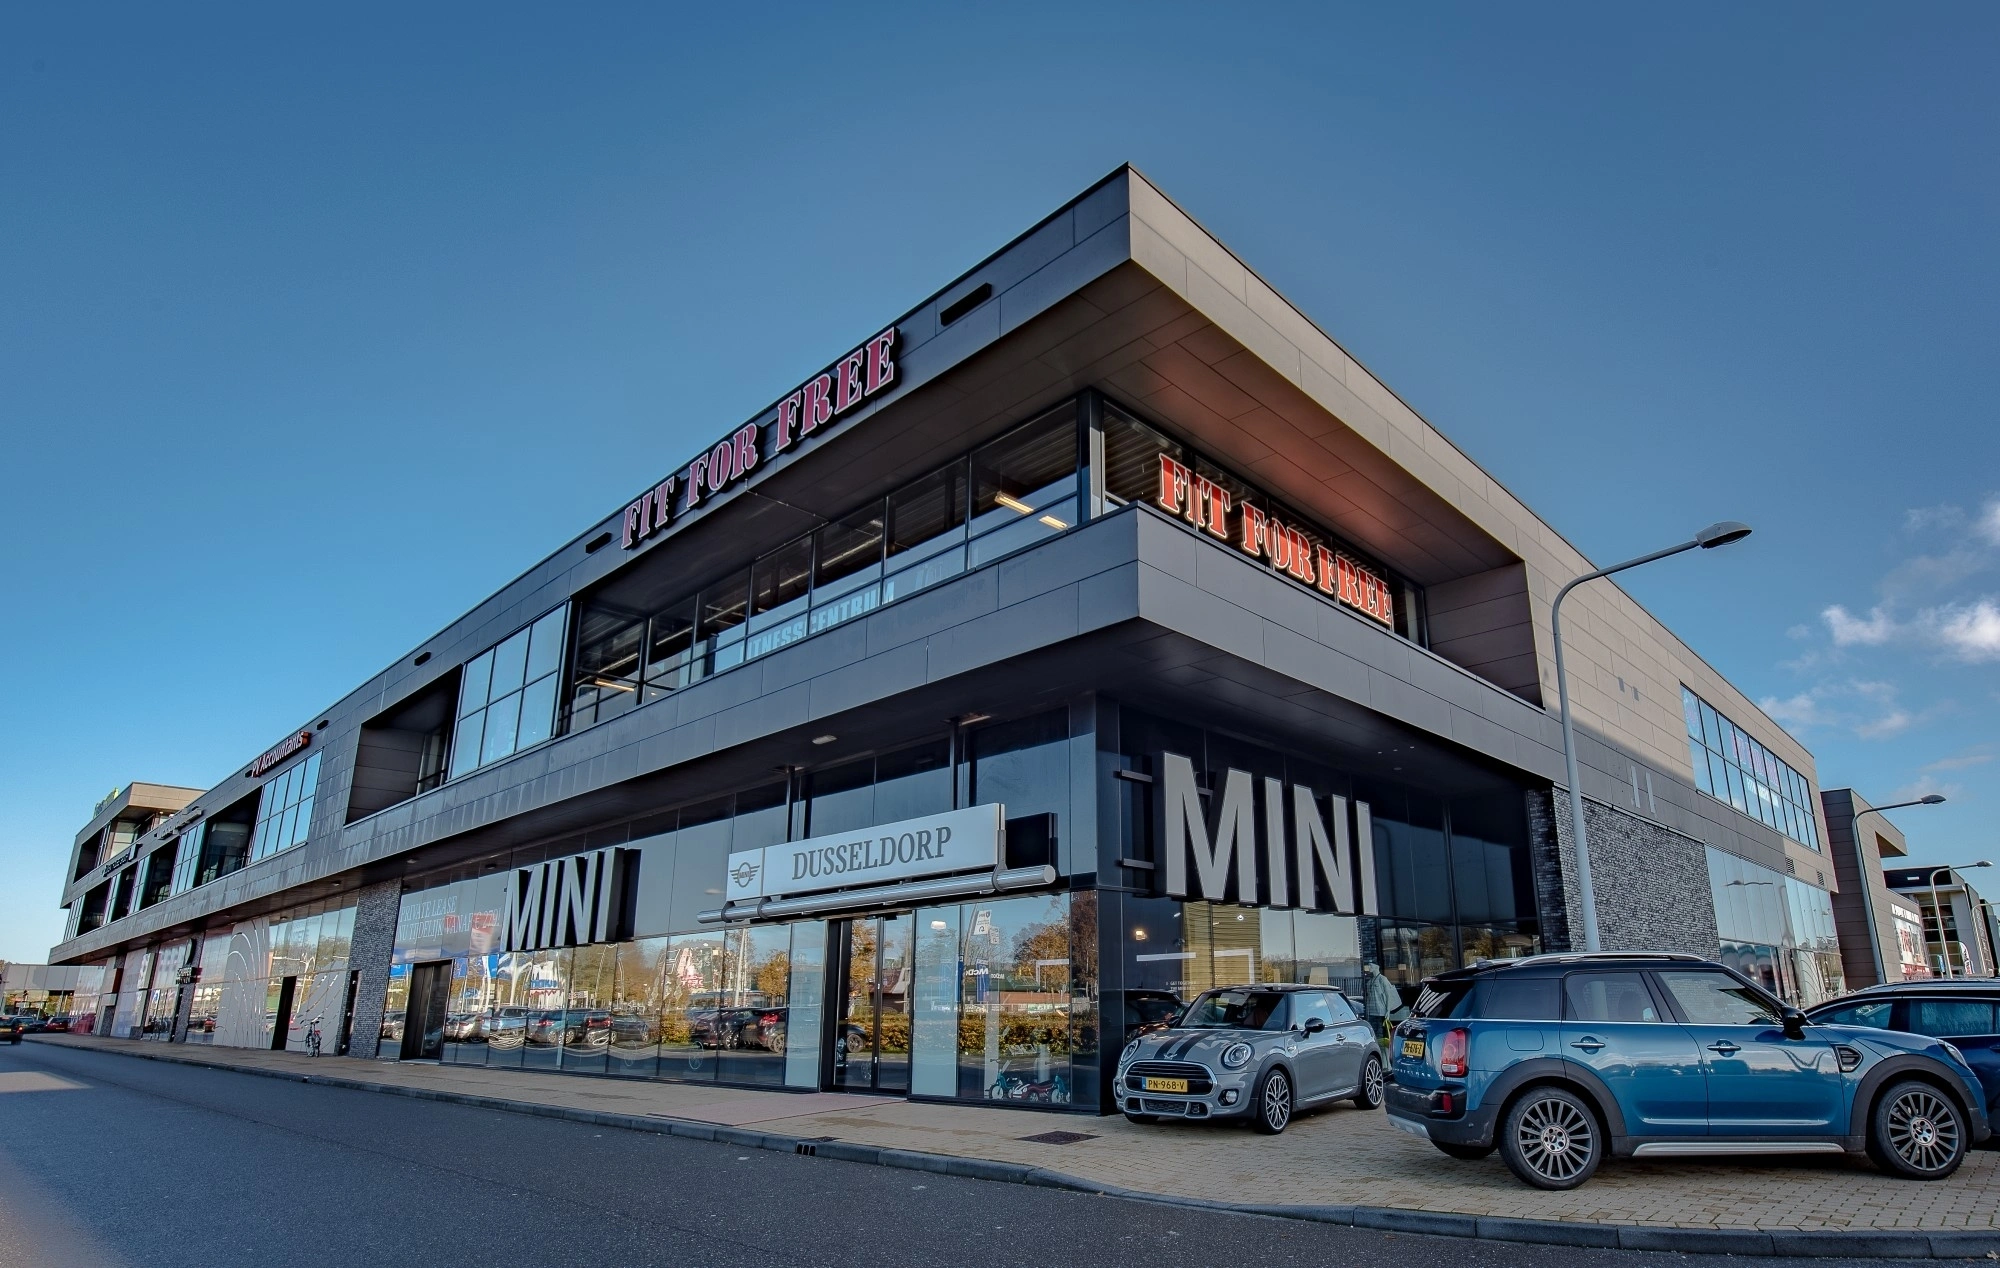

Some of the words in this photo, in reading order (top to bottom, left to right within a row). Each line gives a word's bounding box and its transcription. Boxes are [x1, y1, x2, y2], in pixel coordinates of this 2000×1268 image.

[621, 476, 675, 549] FIT
[686, 423, 758, 508] FOR
[775, 327, 895, 452] FREE
[1158, 452, 1231, 539] FIT
[1241, 500, 1315, 584] FOR
[1316, 543, 1393, 626] FREE
[792, 826, 952, 881] DUSSELDORP
[1162, 751, 1379, 916] MINI
[400, 901, 433, 922] PRIVATE
[432, 895, 458, 917] LEASE
[502, 847, 621, 952] MINI
[1148, 1079, 1185, 1090] PN-968-V
